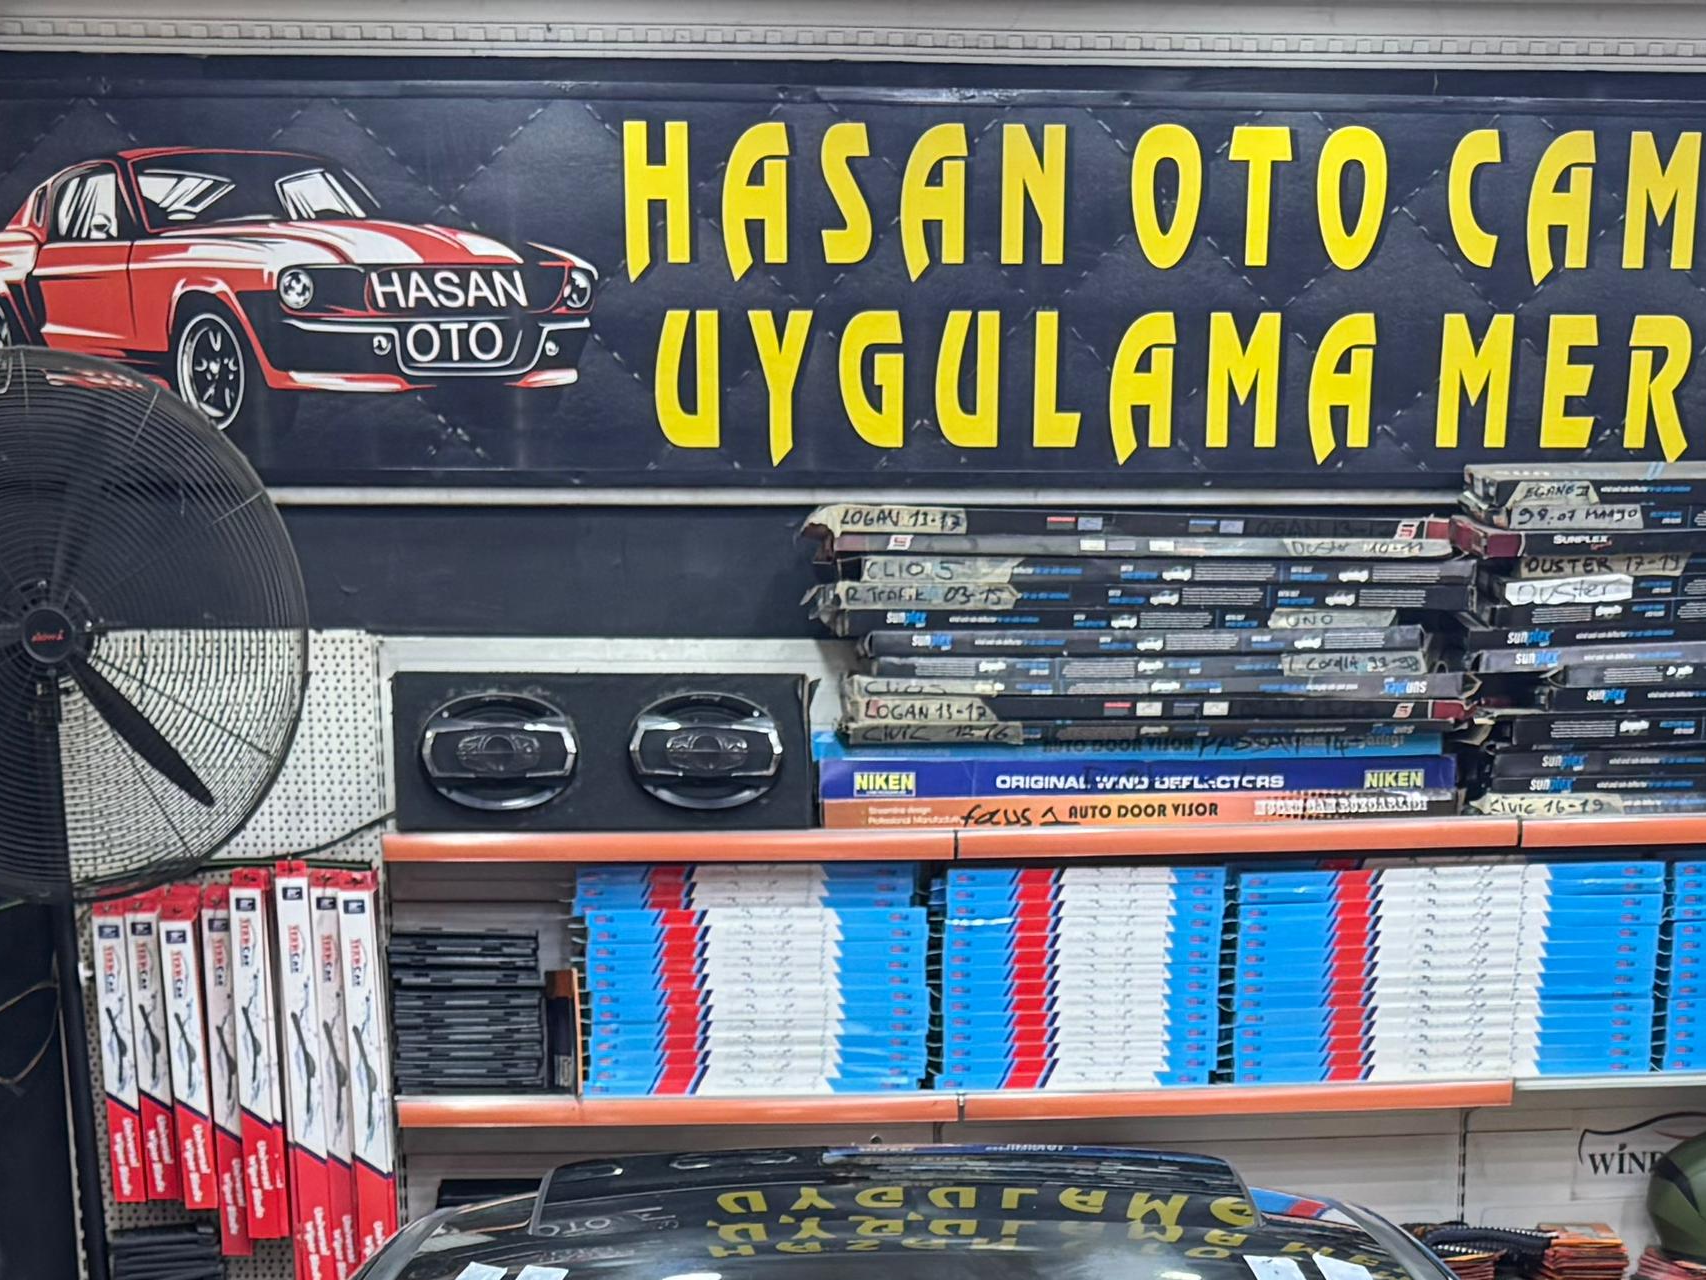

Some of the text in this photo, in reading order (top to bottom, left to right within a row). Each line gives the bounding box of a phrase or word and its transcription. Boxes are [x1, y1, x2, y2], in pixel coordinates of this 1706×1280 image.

[623, 121, 1066, 282] HASAN
[1131, 123, 1387, 270] OTO
[1448, 129, 1702, 286] CAM
[370, 270, 528, 309] HASAN
[405, 321, 503, 363] OTO
[655, 310, 1376, 466] UYGULAMA
[866, 562, 925, 580] CLIO
[864, 700, 930, 720] LOGAN
[855, 772, 914, 791] NIKEN
[996, 775, 1088, 790] ORIGINAL
[1364, 770, 1425, 789] NIKEN
[1068, 802, 1219, 820] AUTO DOOR VISOR
